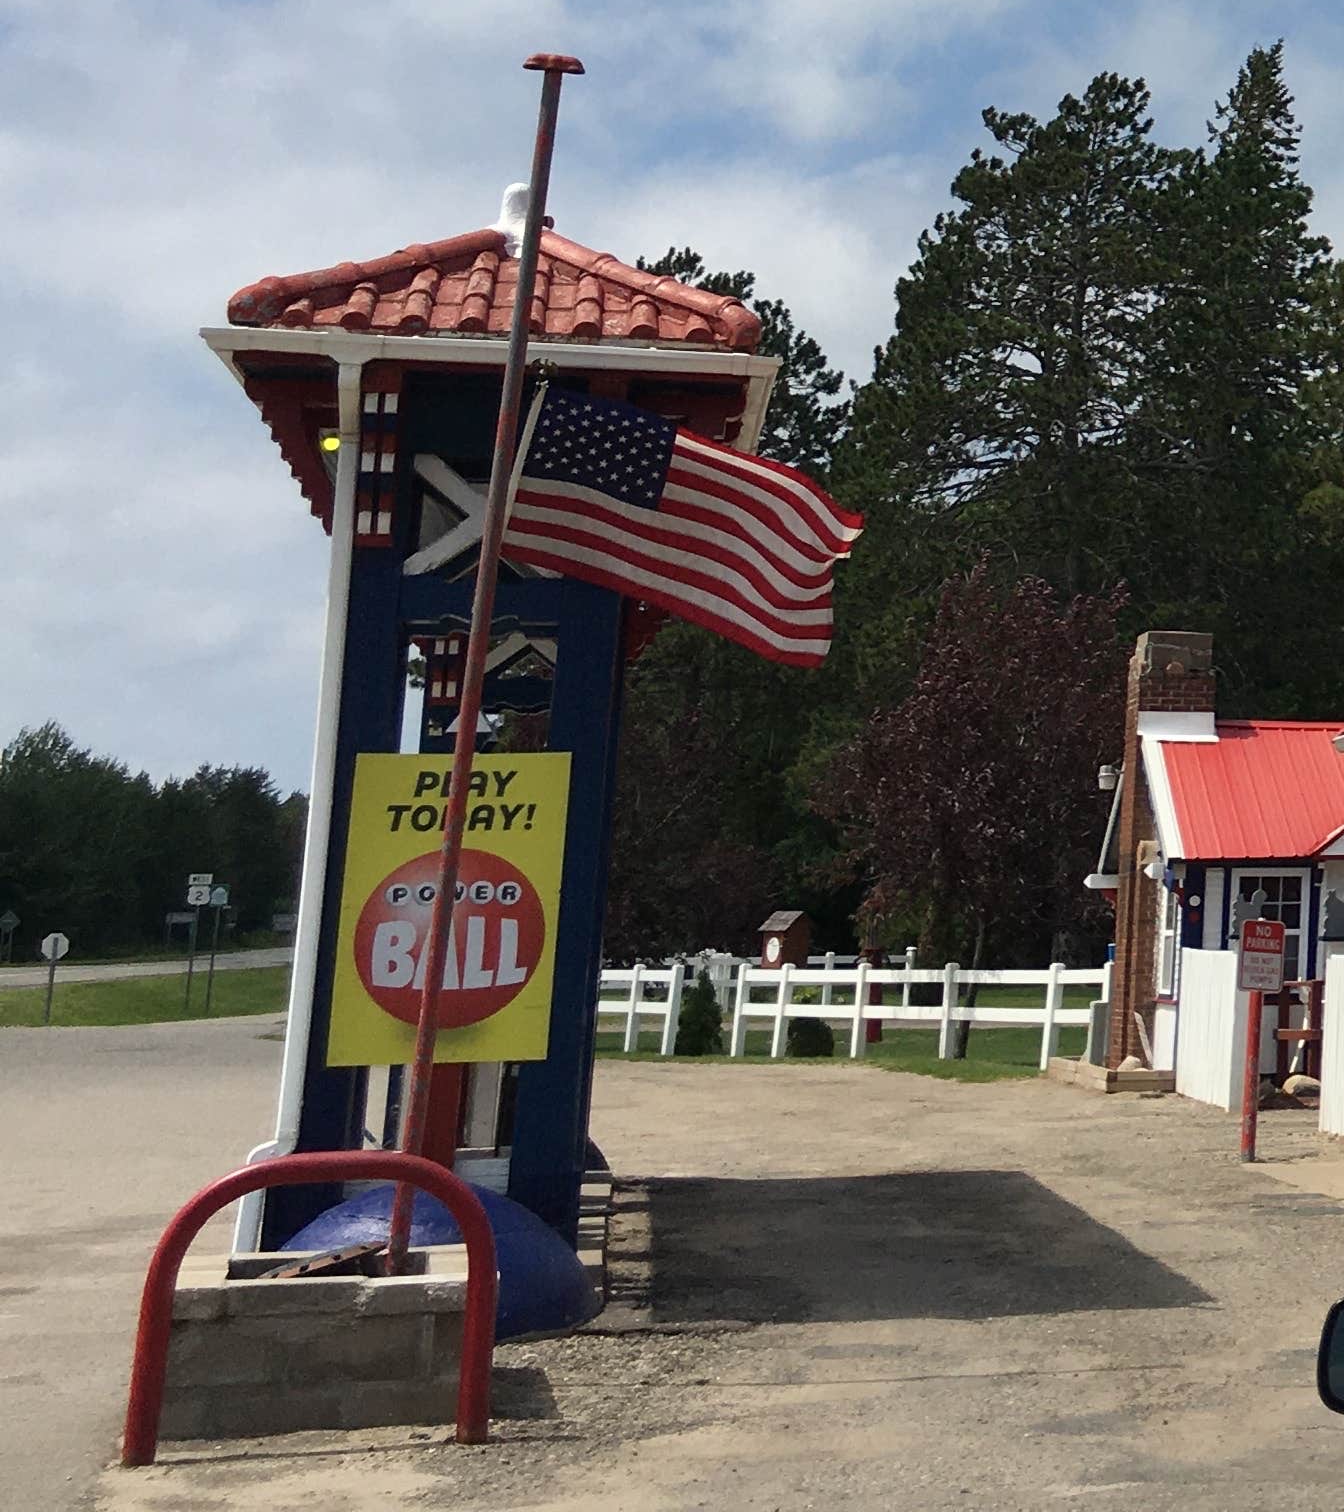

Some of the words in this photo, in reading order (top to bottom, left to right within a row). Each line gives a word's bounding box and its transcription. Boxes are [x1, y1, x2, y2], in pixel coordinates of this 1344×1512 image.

[386, 803, 537, 833] TOAY!
[195, 890, 204, 901] 2
[1255, 925, 1272, 938] NO
[1246, 936, 1281, 951] PARKING
[371, 915, 528, 991] BALL
